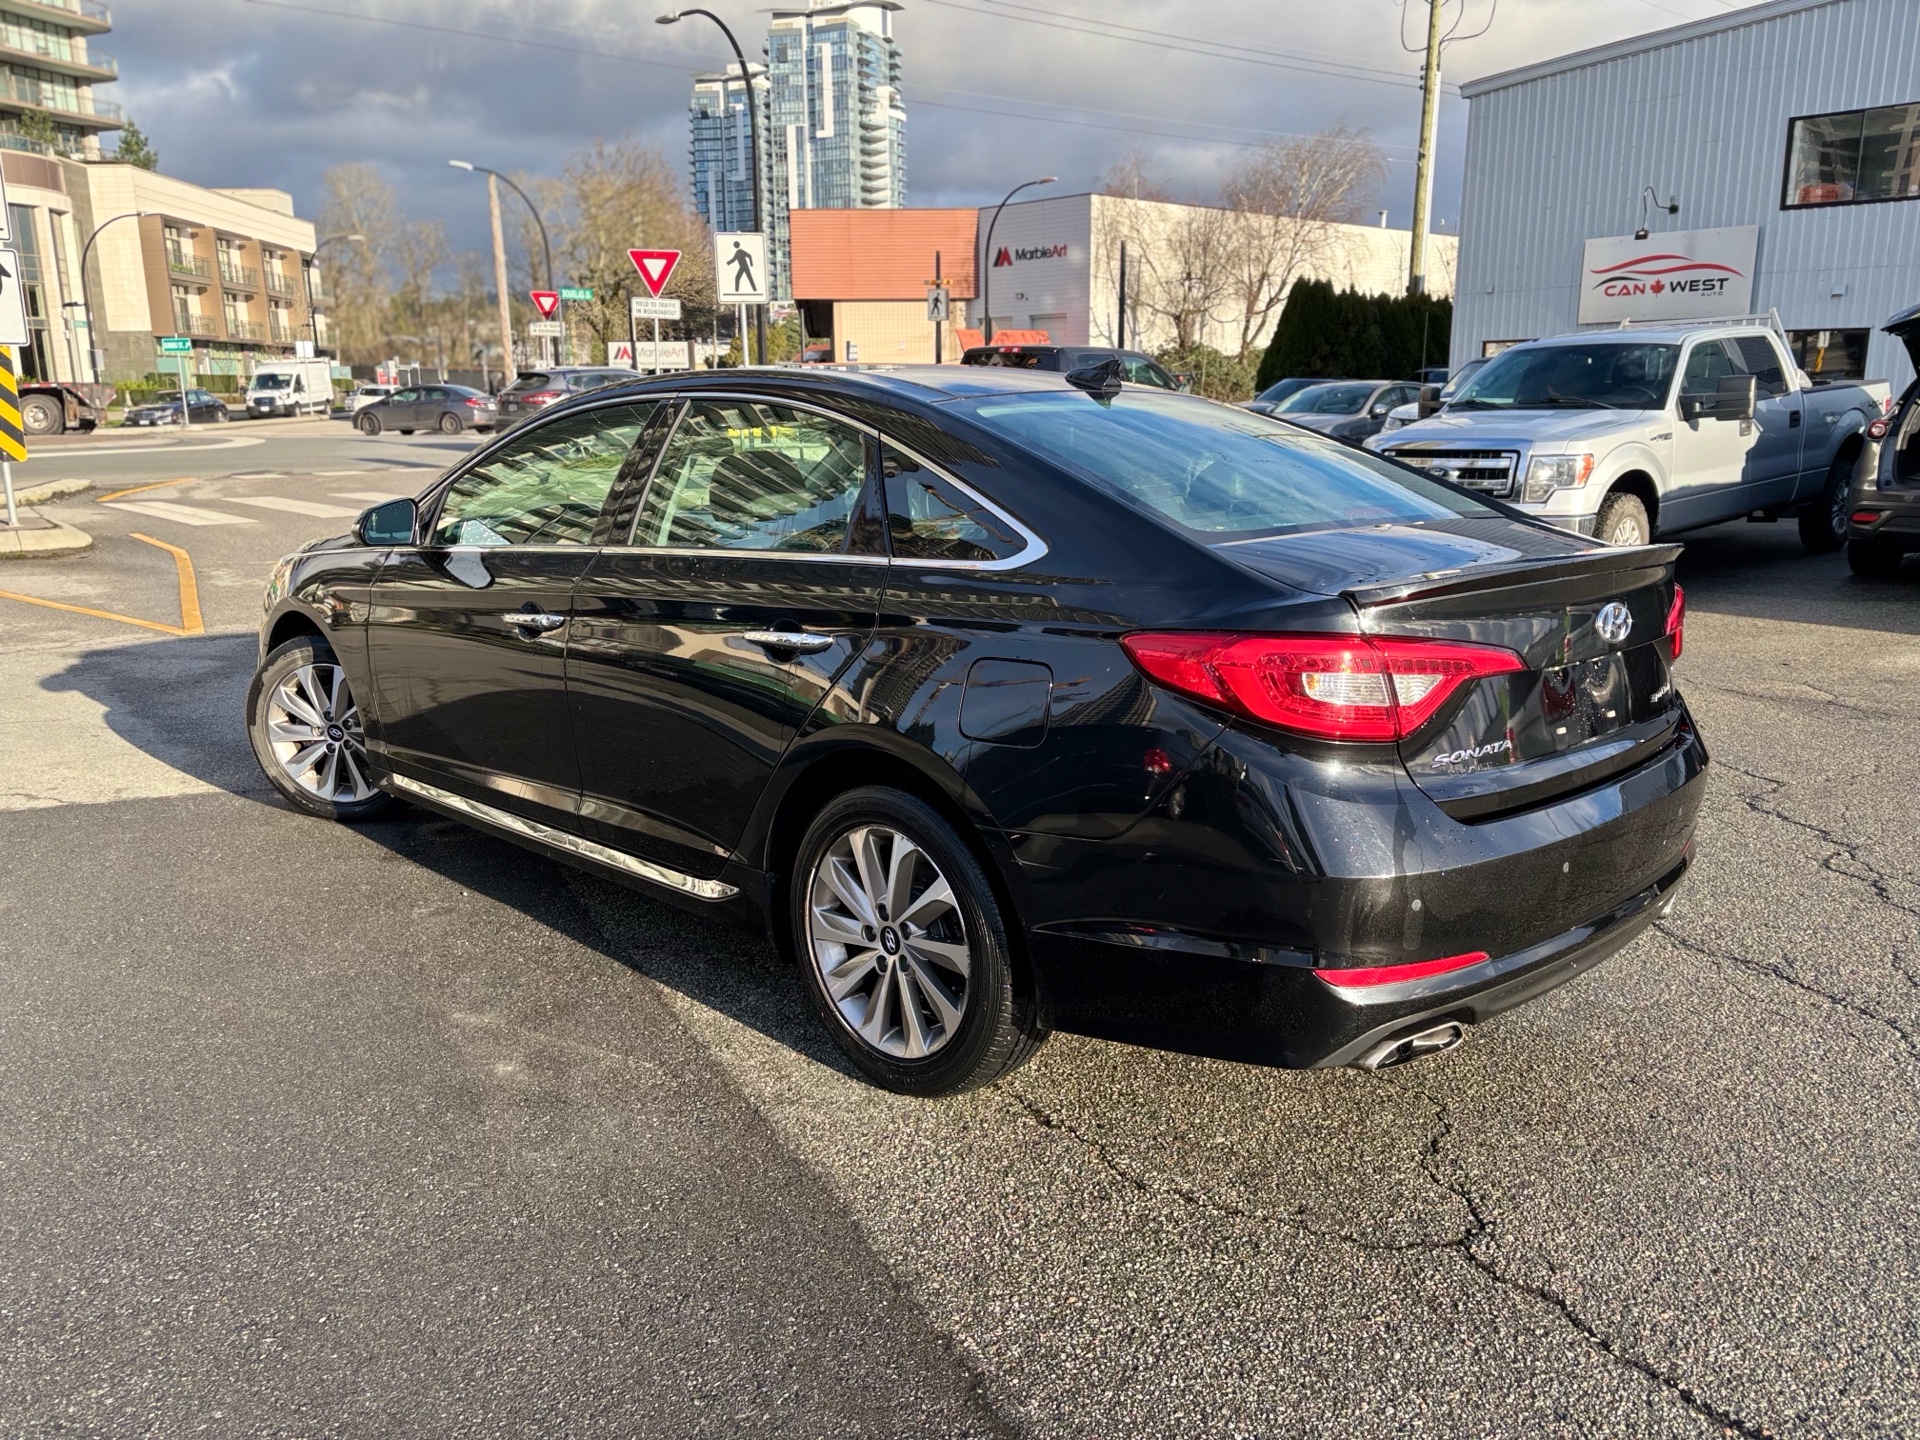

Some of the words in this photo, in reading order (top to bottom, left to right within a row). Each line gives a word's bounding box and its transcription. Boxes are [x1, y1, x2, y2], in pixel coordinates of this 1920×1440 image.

[1015, 243, 1067, 261] MarbleArt
[561, 289, 584, 299] DOUGLAS
[1604, 283, 1646, 297] CAN
[1669, 277, 1730, 293] WEST
[1431, 740, 1513, 768] SONATA
